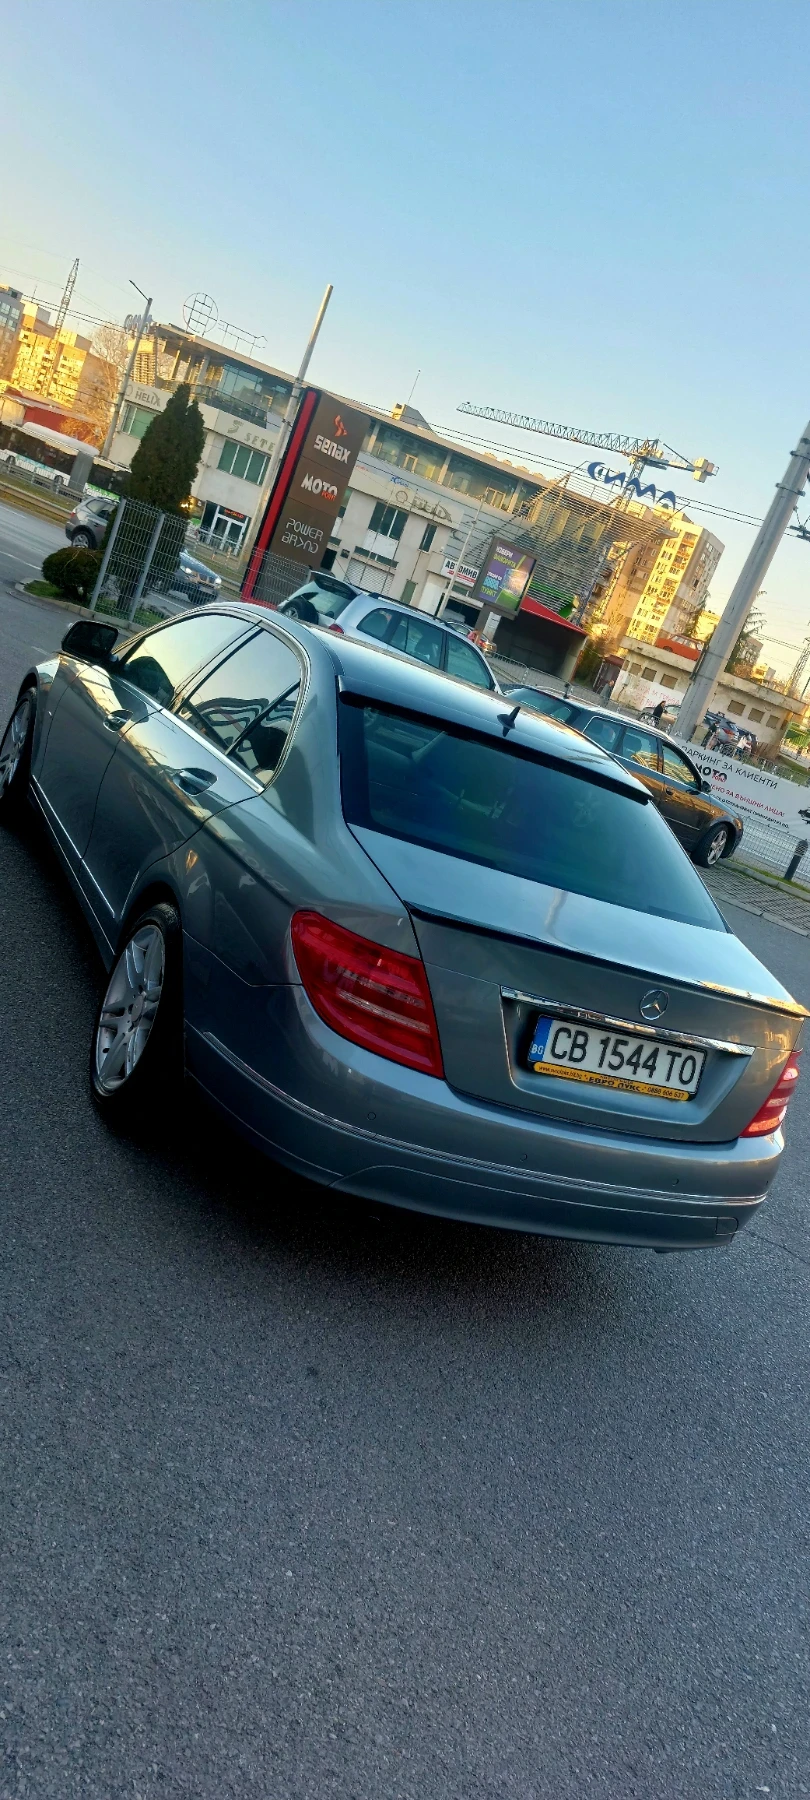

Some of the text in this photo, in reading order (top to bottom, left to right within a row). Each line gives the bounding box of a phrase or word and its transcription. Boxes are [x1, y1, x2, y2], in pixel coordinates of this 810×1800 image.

[134, 390, 161, 408] HELIX
[300, 473, 338, 496] MOTO
[285, 518, 324, 542] POWER
[444, 560, 479, 579] АВОМИВ
[681, 745, 720, 766] ПАРКИНГ
[722, 761, 733, 772] ЗА
[735, 768, 778, 790] КЛИЕНТИ
[725, 787, 734, 798] ЗА
[531, 1044, 544, 1055] BG
[551, 1027, 589, 1063] CB
[598, 1036, 660, 1078] 1544
[665, 1050, 697, 1085] TO
